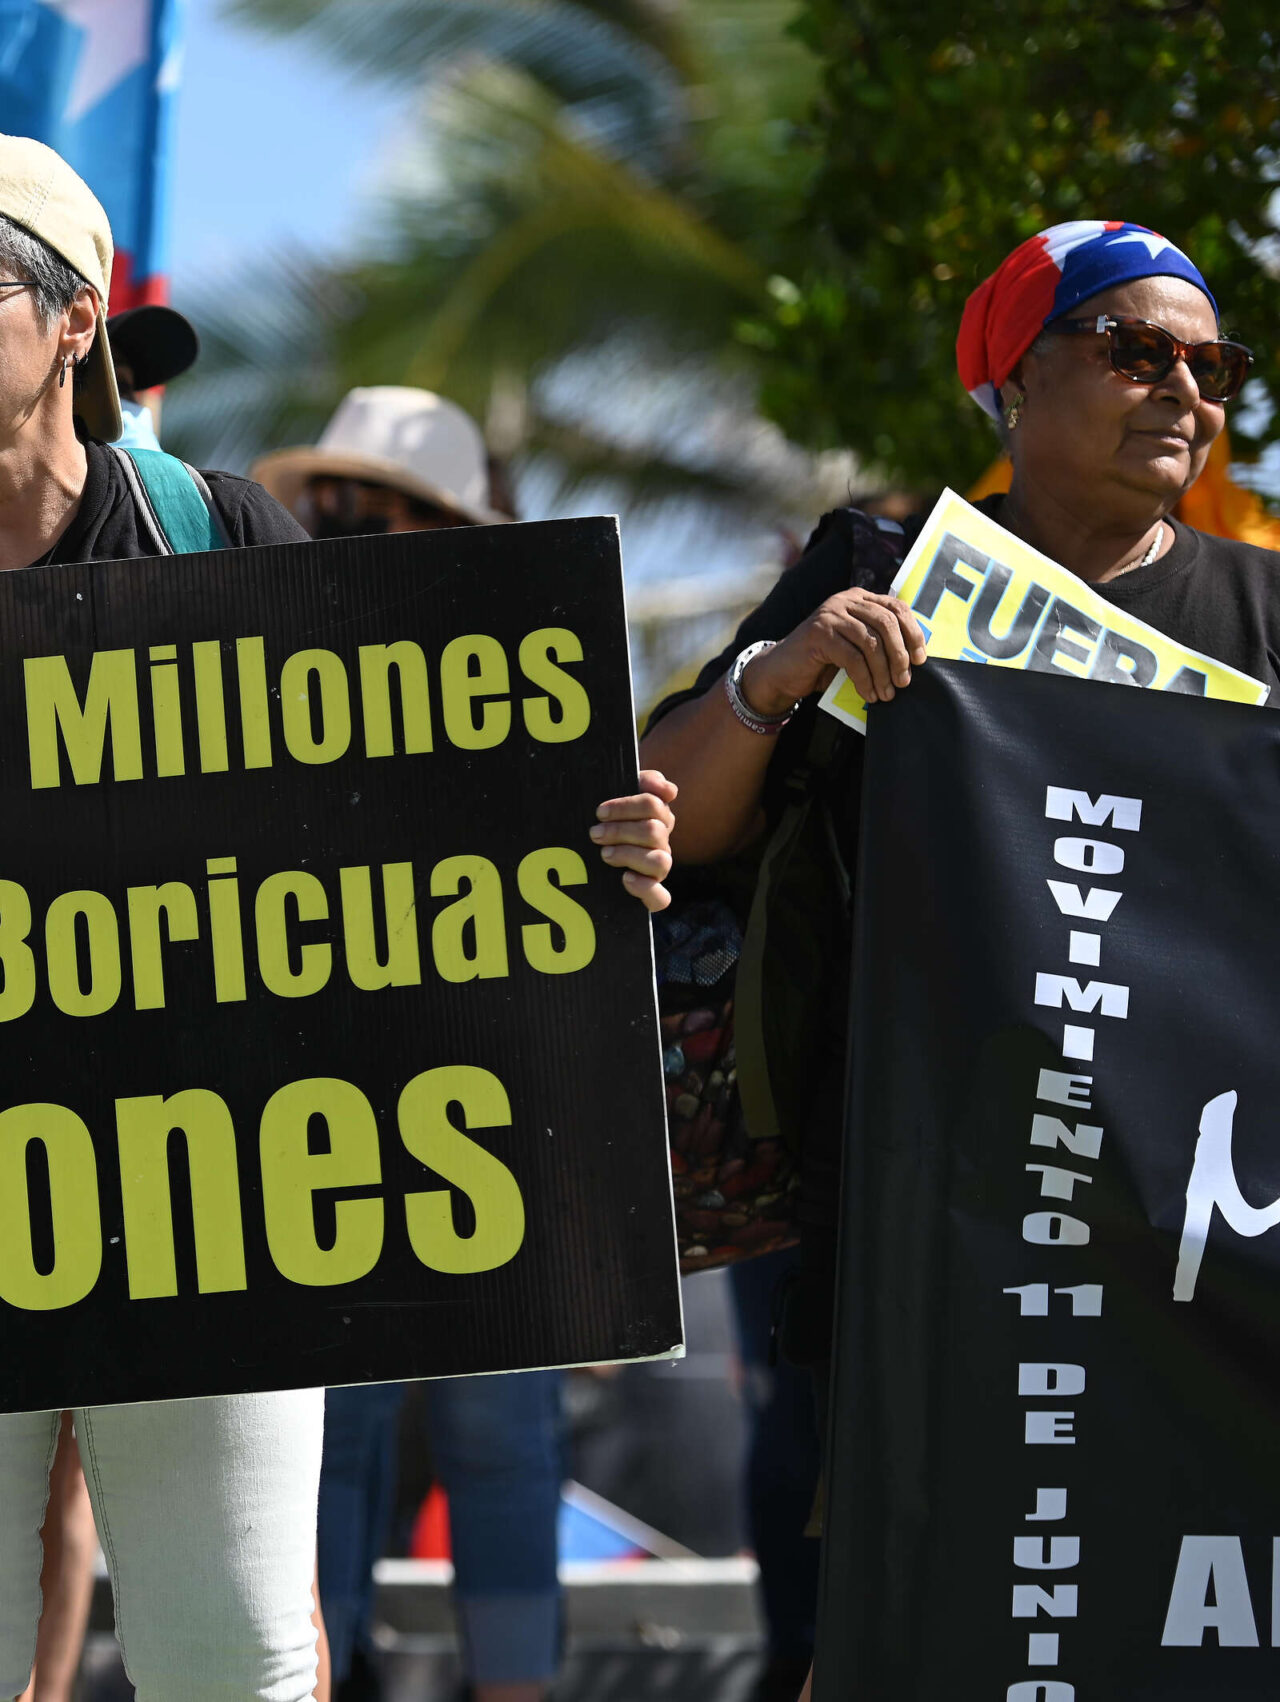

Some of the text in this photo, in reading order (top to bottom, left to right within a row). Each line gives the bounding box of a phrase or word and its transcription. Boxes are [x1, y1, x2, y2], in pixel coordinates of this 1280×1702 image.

[24, 628, 590, 789] Millones
[1022, 785, 1142, 1246] MOVIMIENTO
[1003, 1283, 1103, 1317] 11
[1018, 1363, 1086, 1444] DE
[1161, 1535, 1280, 1648] A
